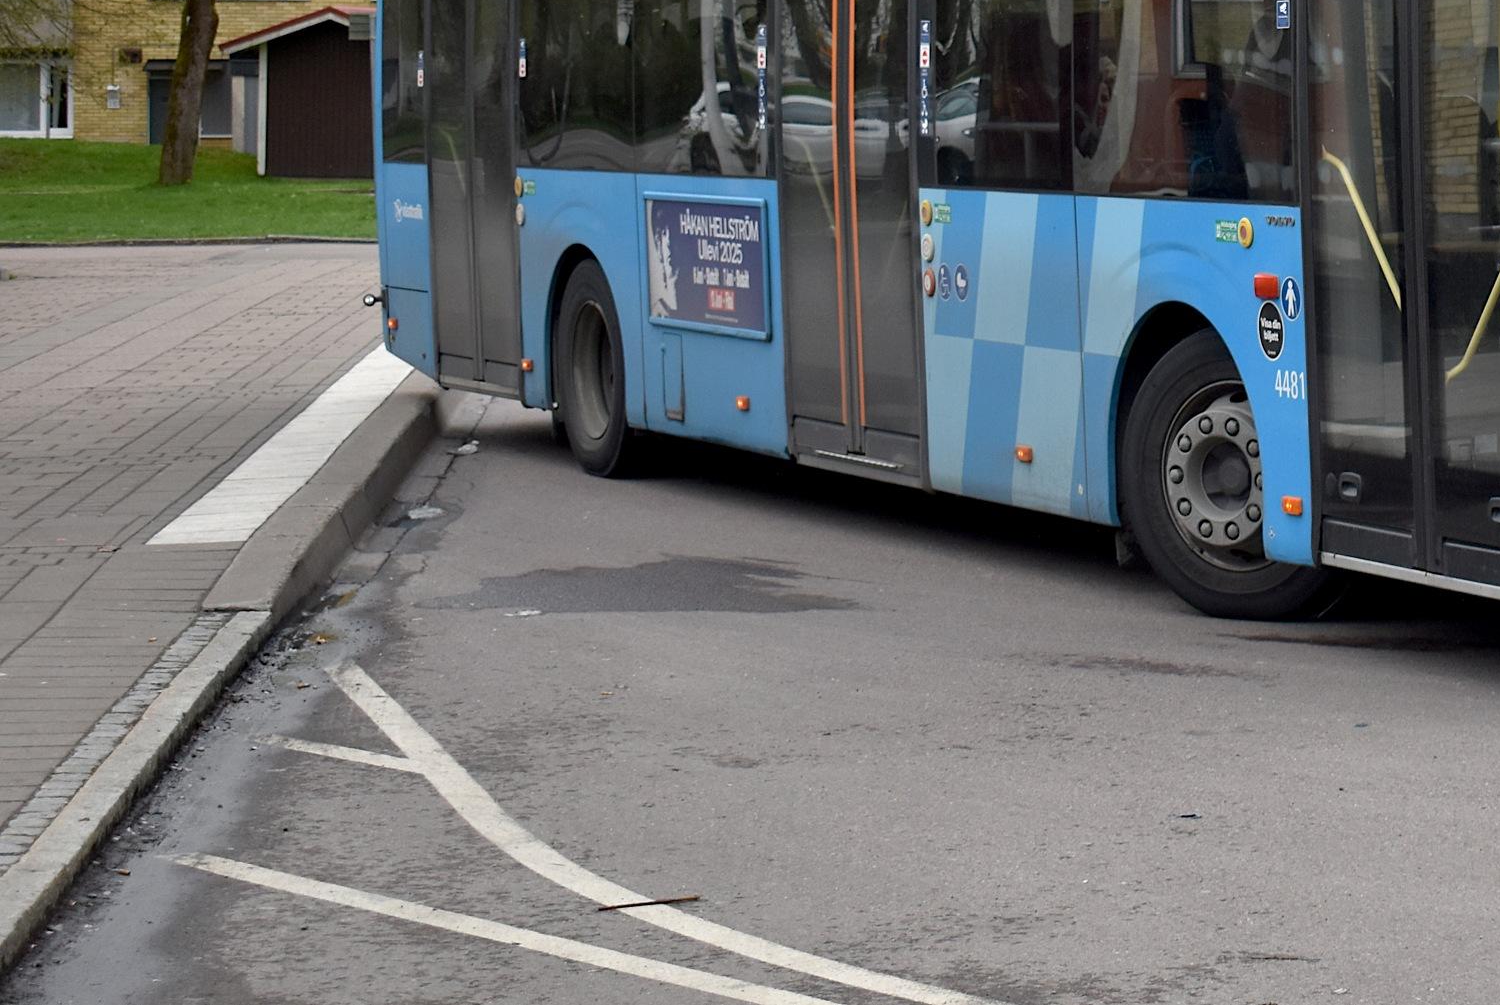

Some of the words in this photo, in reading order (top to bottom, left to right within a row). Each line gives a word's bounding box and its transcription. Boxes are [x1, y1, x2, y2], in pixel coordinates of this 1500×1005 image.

[680, 208, 709, 237] HÅKAN
[709, 215, 760, 243] HELLSTRÖM
[697, 239, 720, 263] Ullevi
[720, 241, 743, 265] 2025
[1275, 369, 1306, 400] 4481
